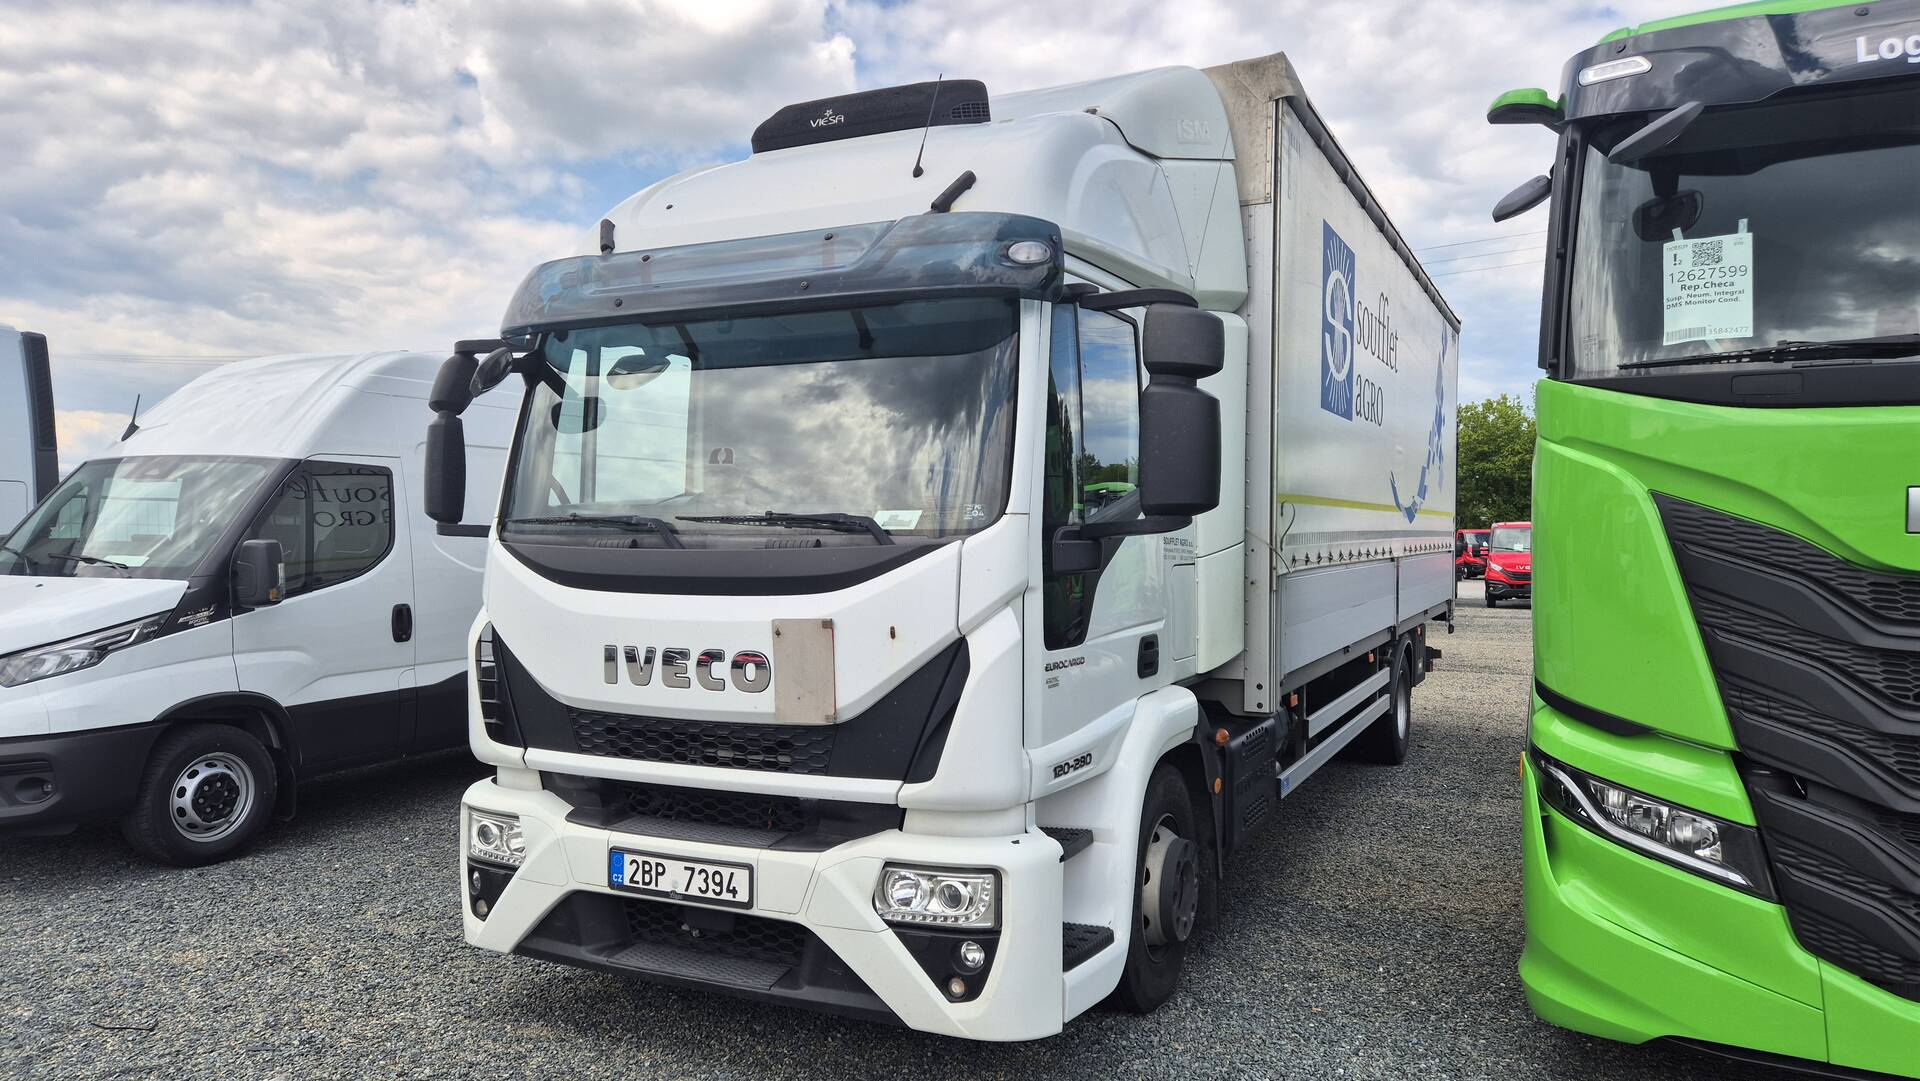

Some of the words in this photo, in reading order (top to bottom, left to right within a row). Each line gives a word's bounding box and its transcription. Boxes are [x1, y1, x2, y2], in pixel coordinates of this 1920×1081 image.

[810, 114, 844, 128] VIESA
[1669, 264, 1748, 283] 12627599
[1680, 281, 1735, 291] Rep.Checa
[1666, 295, 1684, 303] Susp.
[1714, 289, 1745, 297] Integral
[1666, 301, 1682, 310] DMS
[1356, 291, 1399, 374] soufflet
[603, 644, 772, 693] IVECO
[1044, 656, 1086, 672] EUROCARGO
[1053, 753, 1092, 779] 120-280
[612, 873, 623, 882] CZ
[628, 858, 667, 888] 2BP
[683, 866, 738, 899] 7394
